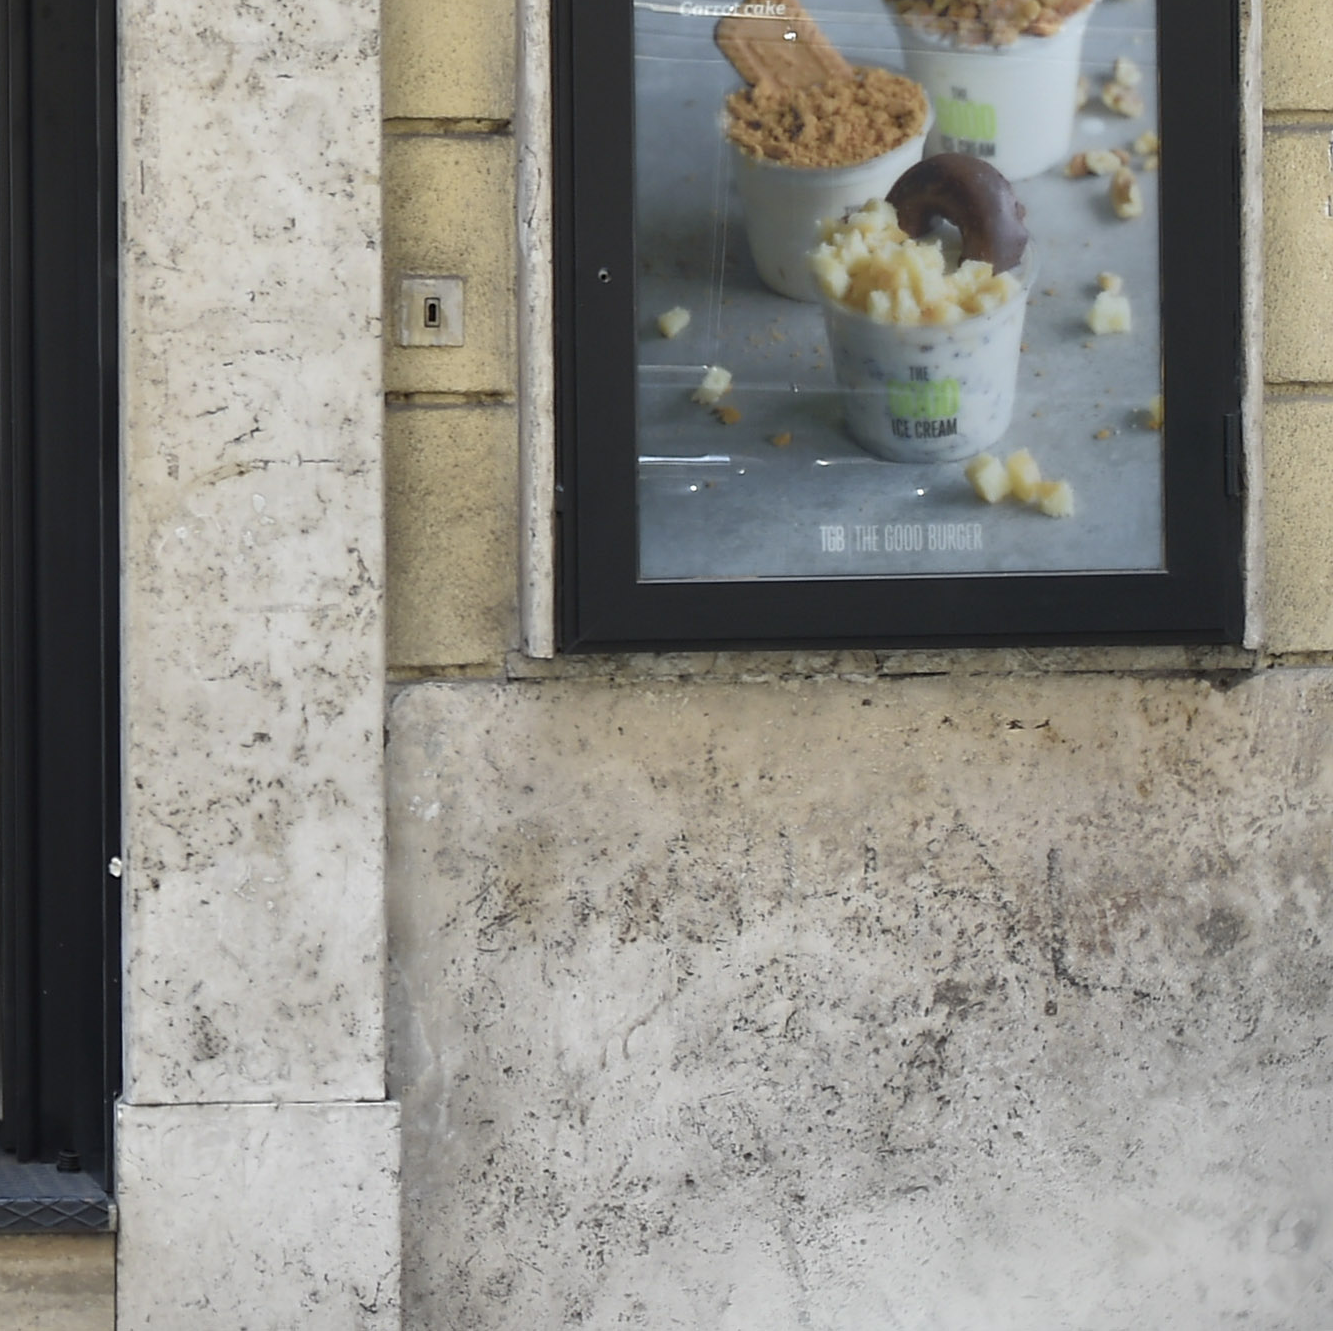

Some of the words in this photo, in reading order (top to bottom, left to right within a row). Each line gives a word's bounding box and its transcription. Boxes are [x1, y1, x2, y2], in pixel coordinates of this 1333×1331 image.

[744, 0, 786, 16] cake
[915, 418, 958, 438] CREAM
[820, 526, 845, 552] TGB
[855, 525, 879, 551] THE
[885, 524, 923, 551] GOOD
[928, 523, 983, 550] BURGER
